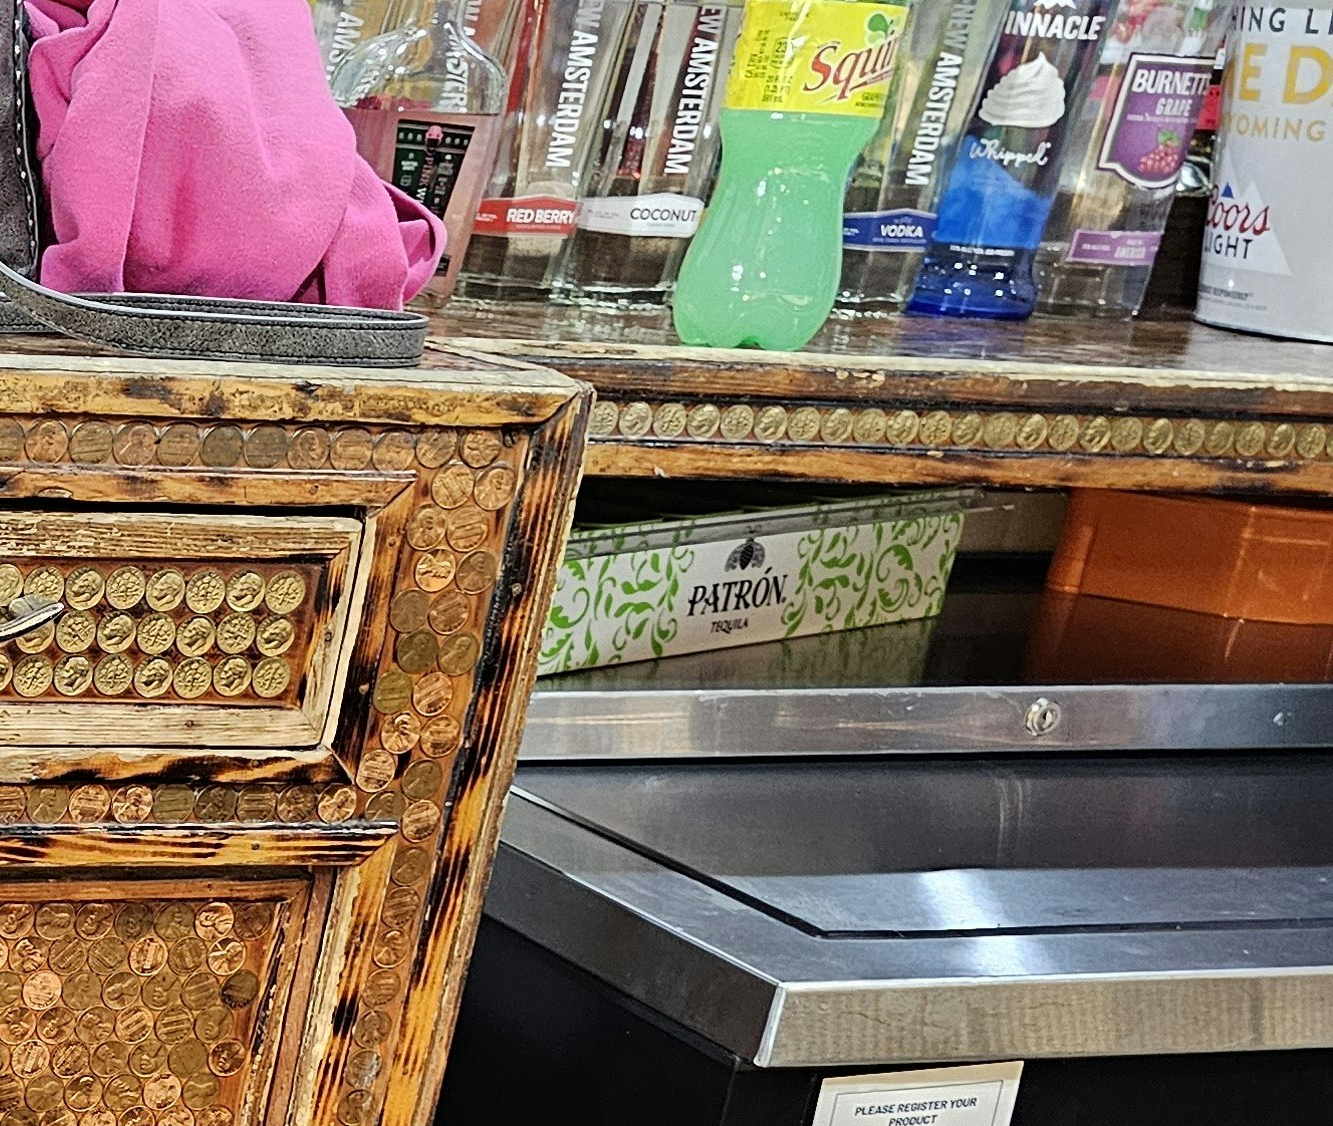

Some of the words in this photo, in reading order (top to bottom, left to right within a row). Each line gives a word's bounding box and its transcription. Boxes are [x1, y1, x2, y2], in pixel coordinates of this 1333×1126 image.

[697, 4, 727, 34] EW
[1004, 10, 1106, 40] INNACLE
[803, 29, 896, 100] Squi
[545, 30, 599, 168] AMSTERDAM
[664, 37, 719, 174] AMSTERDAM
[1155, 97, 1193, 117] GRAPE
[905, 51, 963, 186] AMSTERDAM
[506, 208, 535, 224] RED
[534, 209, 576, 225] BERRY
[630, 207, 698, 222] COCONUT
[880, 224, 924, 238] VODKA
[686, 566, 788, 618] PATRÓN
[710, 617, 750, 635] TEQUILA
[854, 1104, 896, 1117] PLEASE
[897, 1100, 949, 1114] REGISTER
[950, 1097, 977, 1109] YOUR
